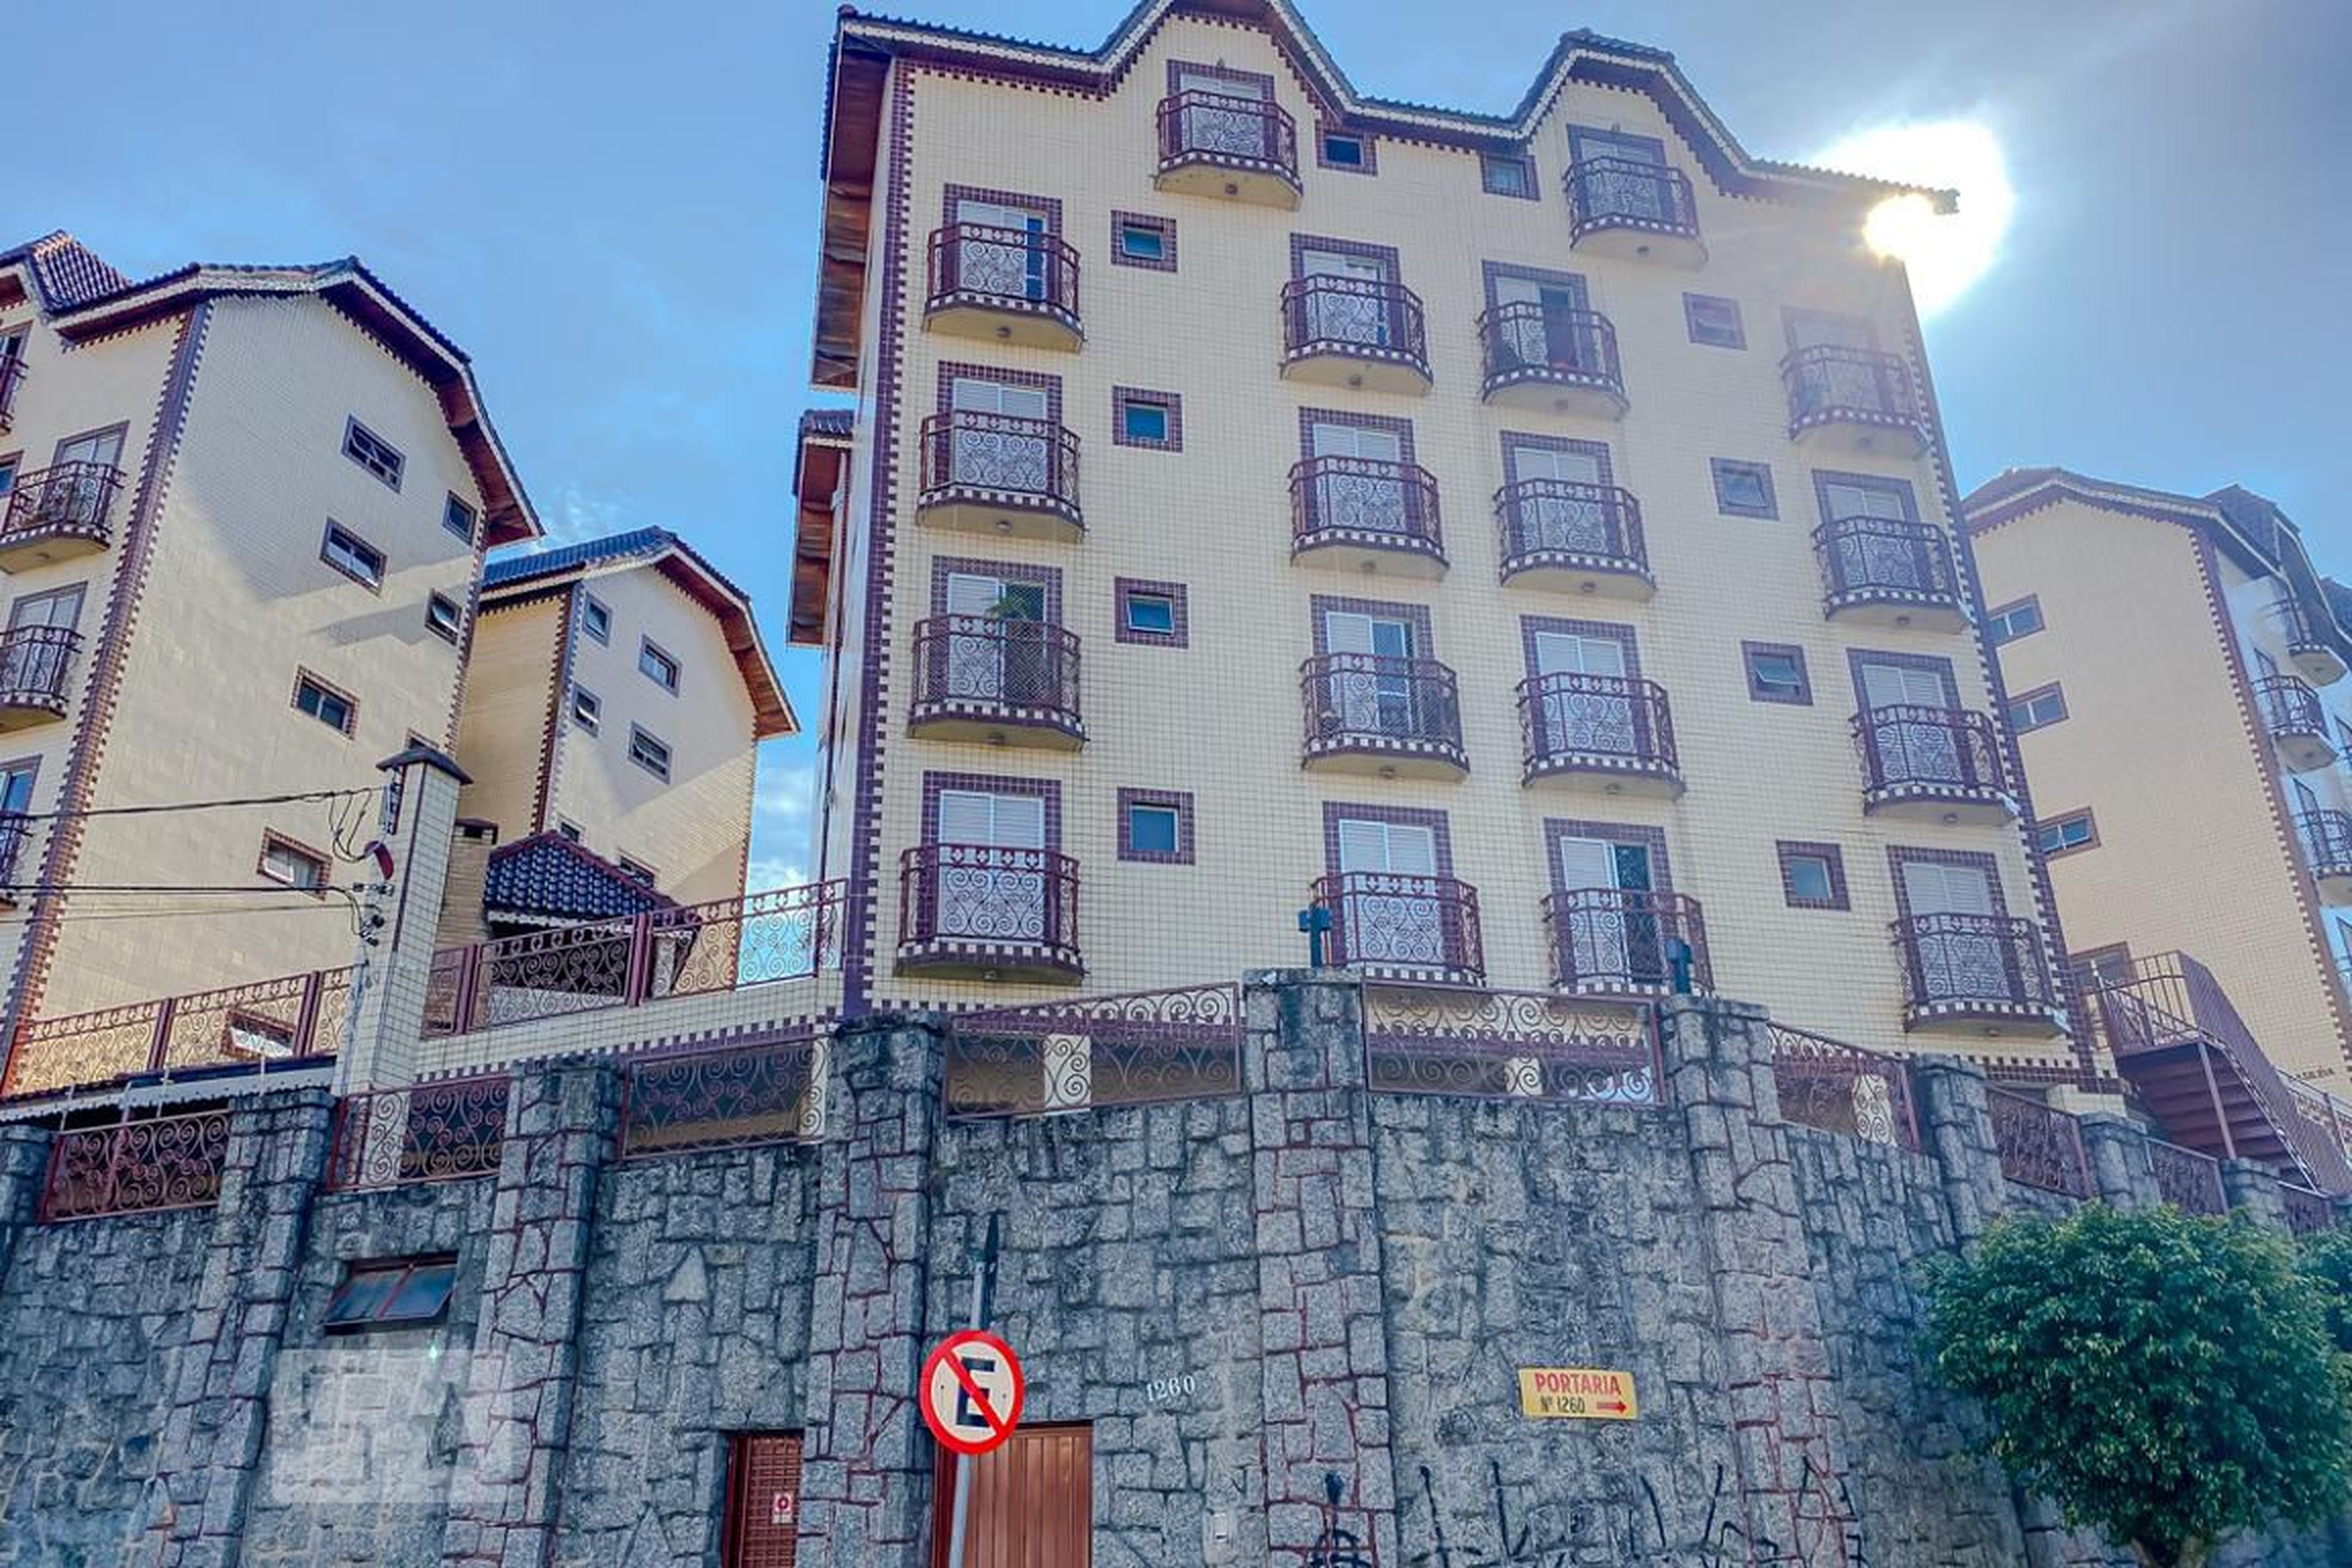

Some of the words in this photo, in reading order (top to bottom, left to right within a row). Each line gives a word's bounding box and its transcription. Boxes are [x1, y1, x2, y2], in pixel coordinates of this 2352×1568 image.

[956, 1357, 995, 1427] E
[1147, 1376, 1195, 1401] 1260
[1535, 1373, 1621, 1395] PORTARIA
[1557, 1396, 1585, 1414] 1260
